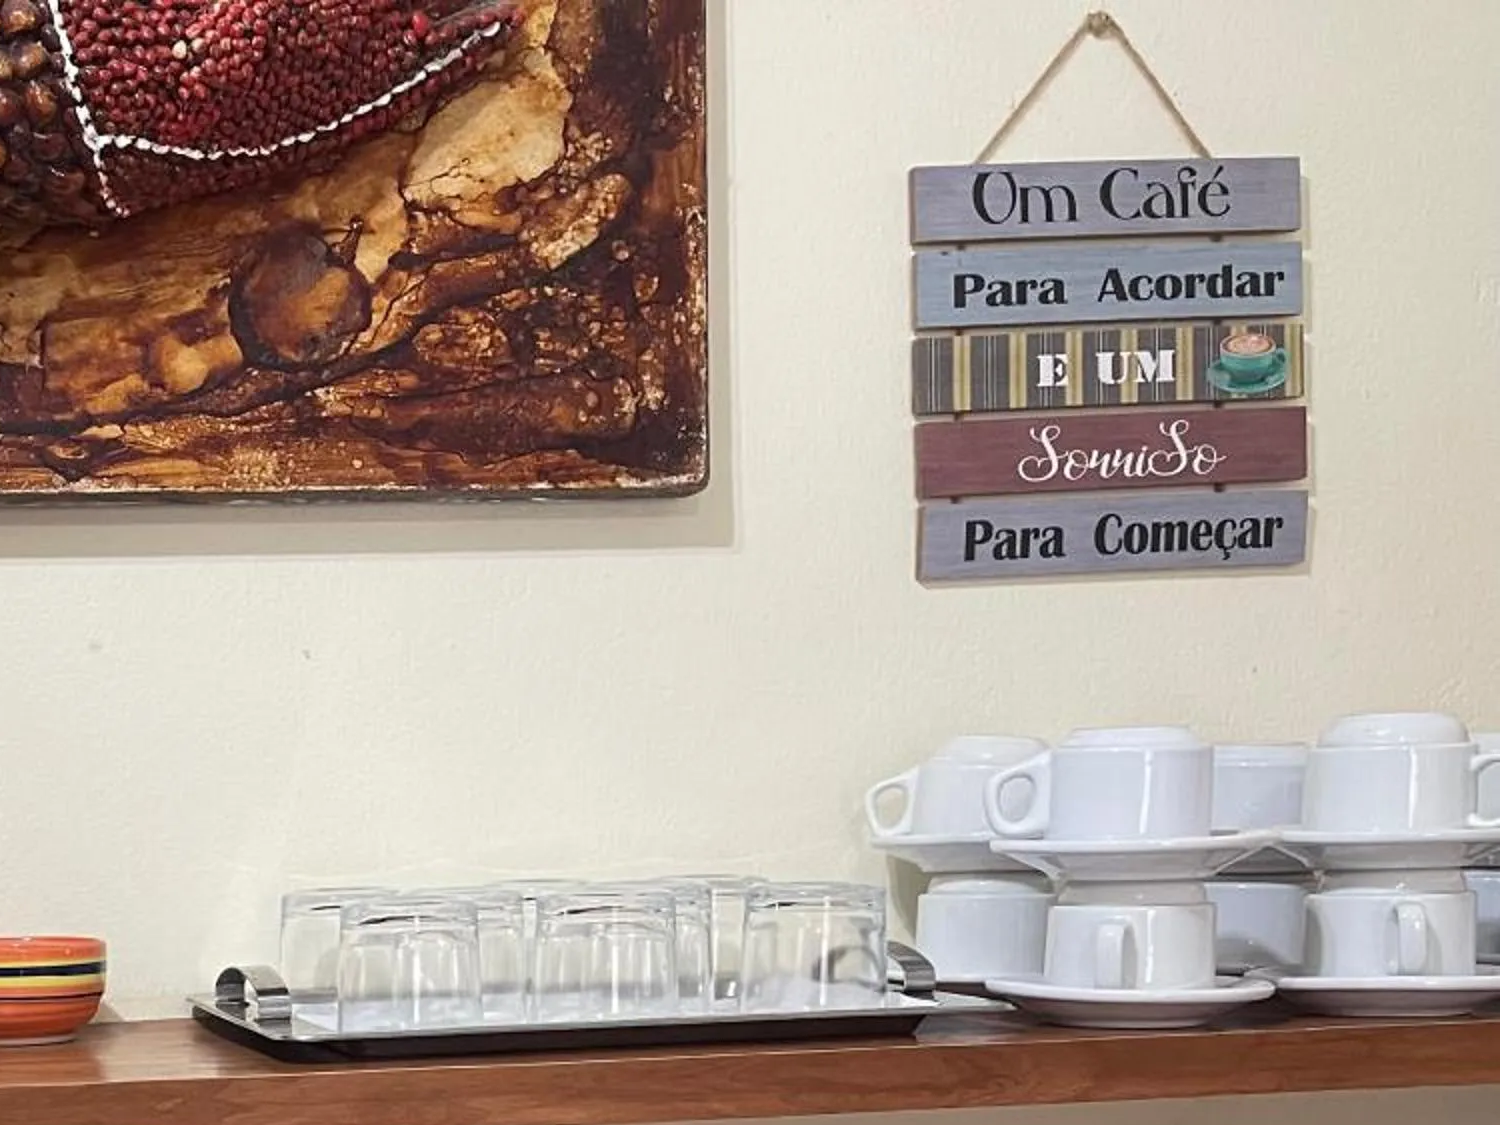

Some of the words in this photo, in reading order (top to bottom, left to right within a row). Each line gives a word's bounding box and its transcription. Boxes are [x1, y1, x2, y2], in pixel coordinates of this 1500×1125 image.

[1100, 164, 1232, 221] Café
[953, 273, 1068, 309] Para
[1097, 264, 1285, 303] Acordar
[1037, 353, 1068, 387] E
[1097, 349, 1176, 385] UM
[964, 519, 1065, 562] Para
[1094, 514, 1284, 560] Começar
